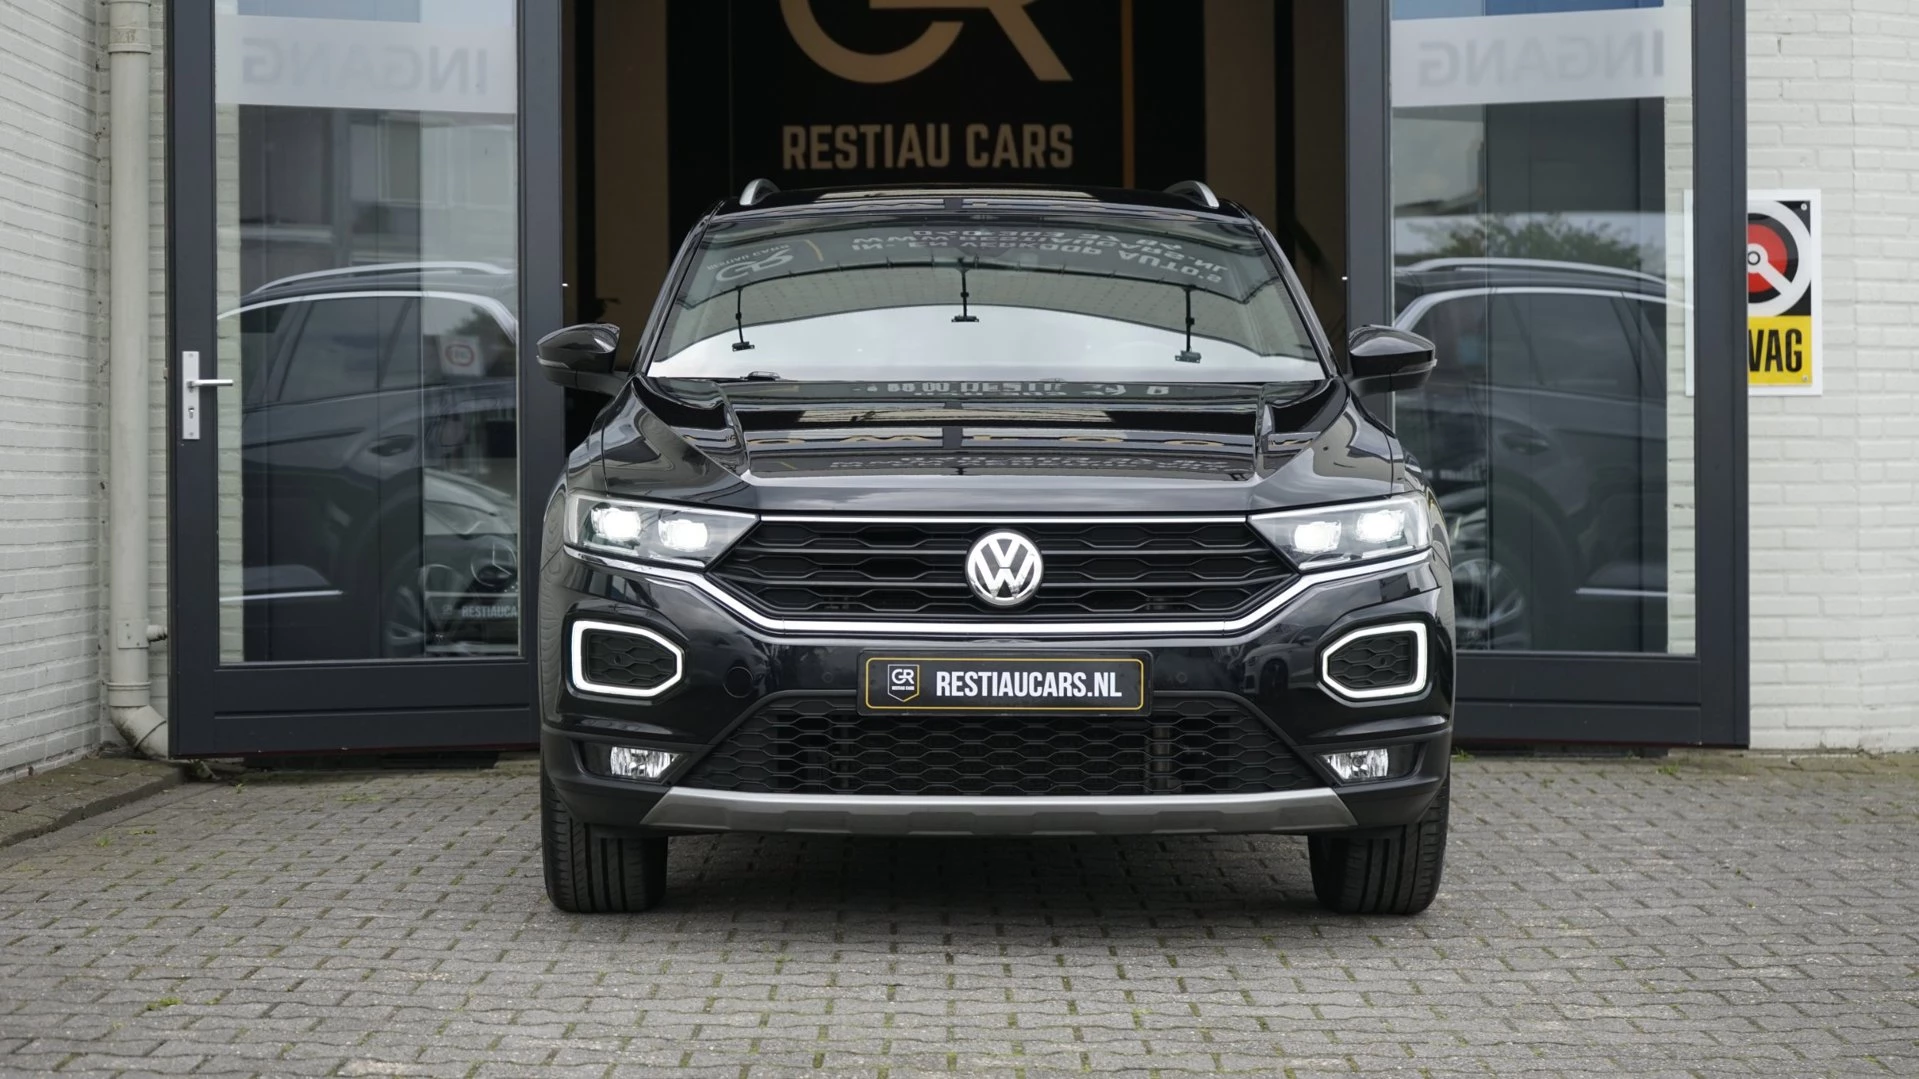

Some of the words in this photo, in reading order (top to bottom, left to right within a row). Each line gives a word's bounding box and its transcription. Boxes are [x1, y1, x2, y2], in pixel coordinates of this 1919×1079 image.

[782, 124, 950, 170] RESTIAU
[966, 124, 1074, 169] CARS
[892, 669, 915, 684] GR
[936, 671, 1122, 697] RESTIAUCARS.NL
